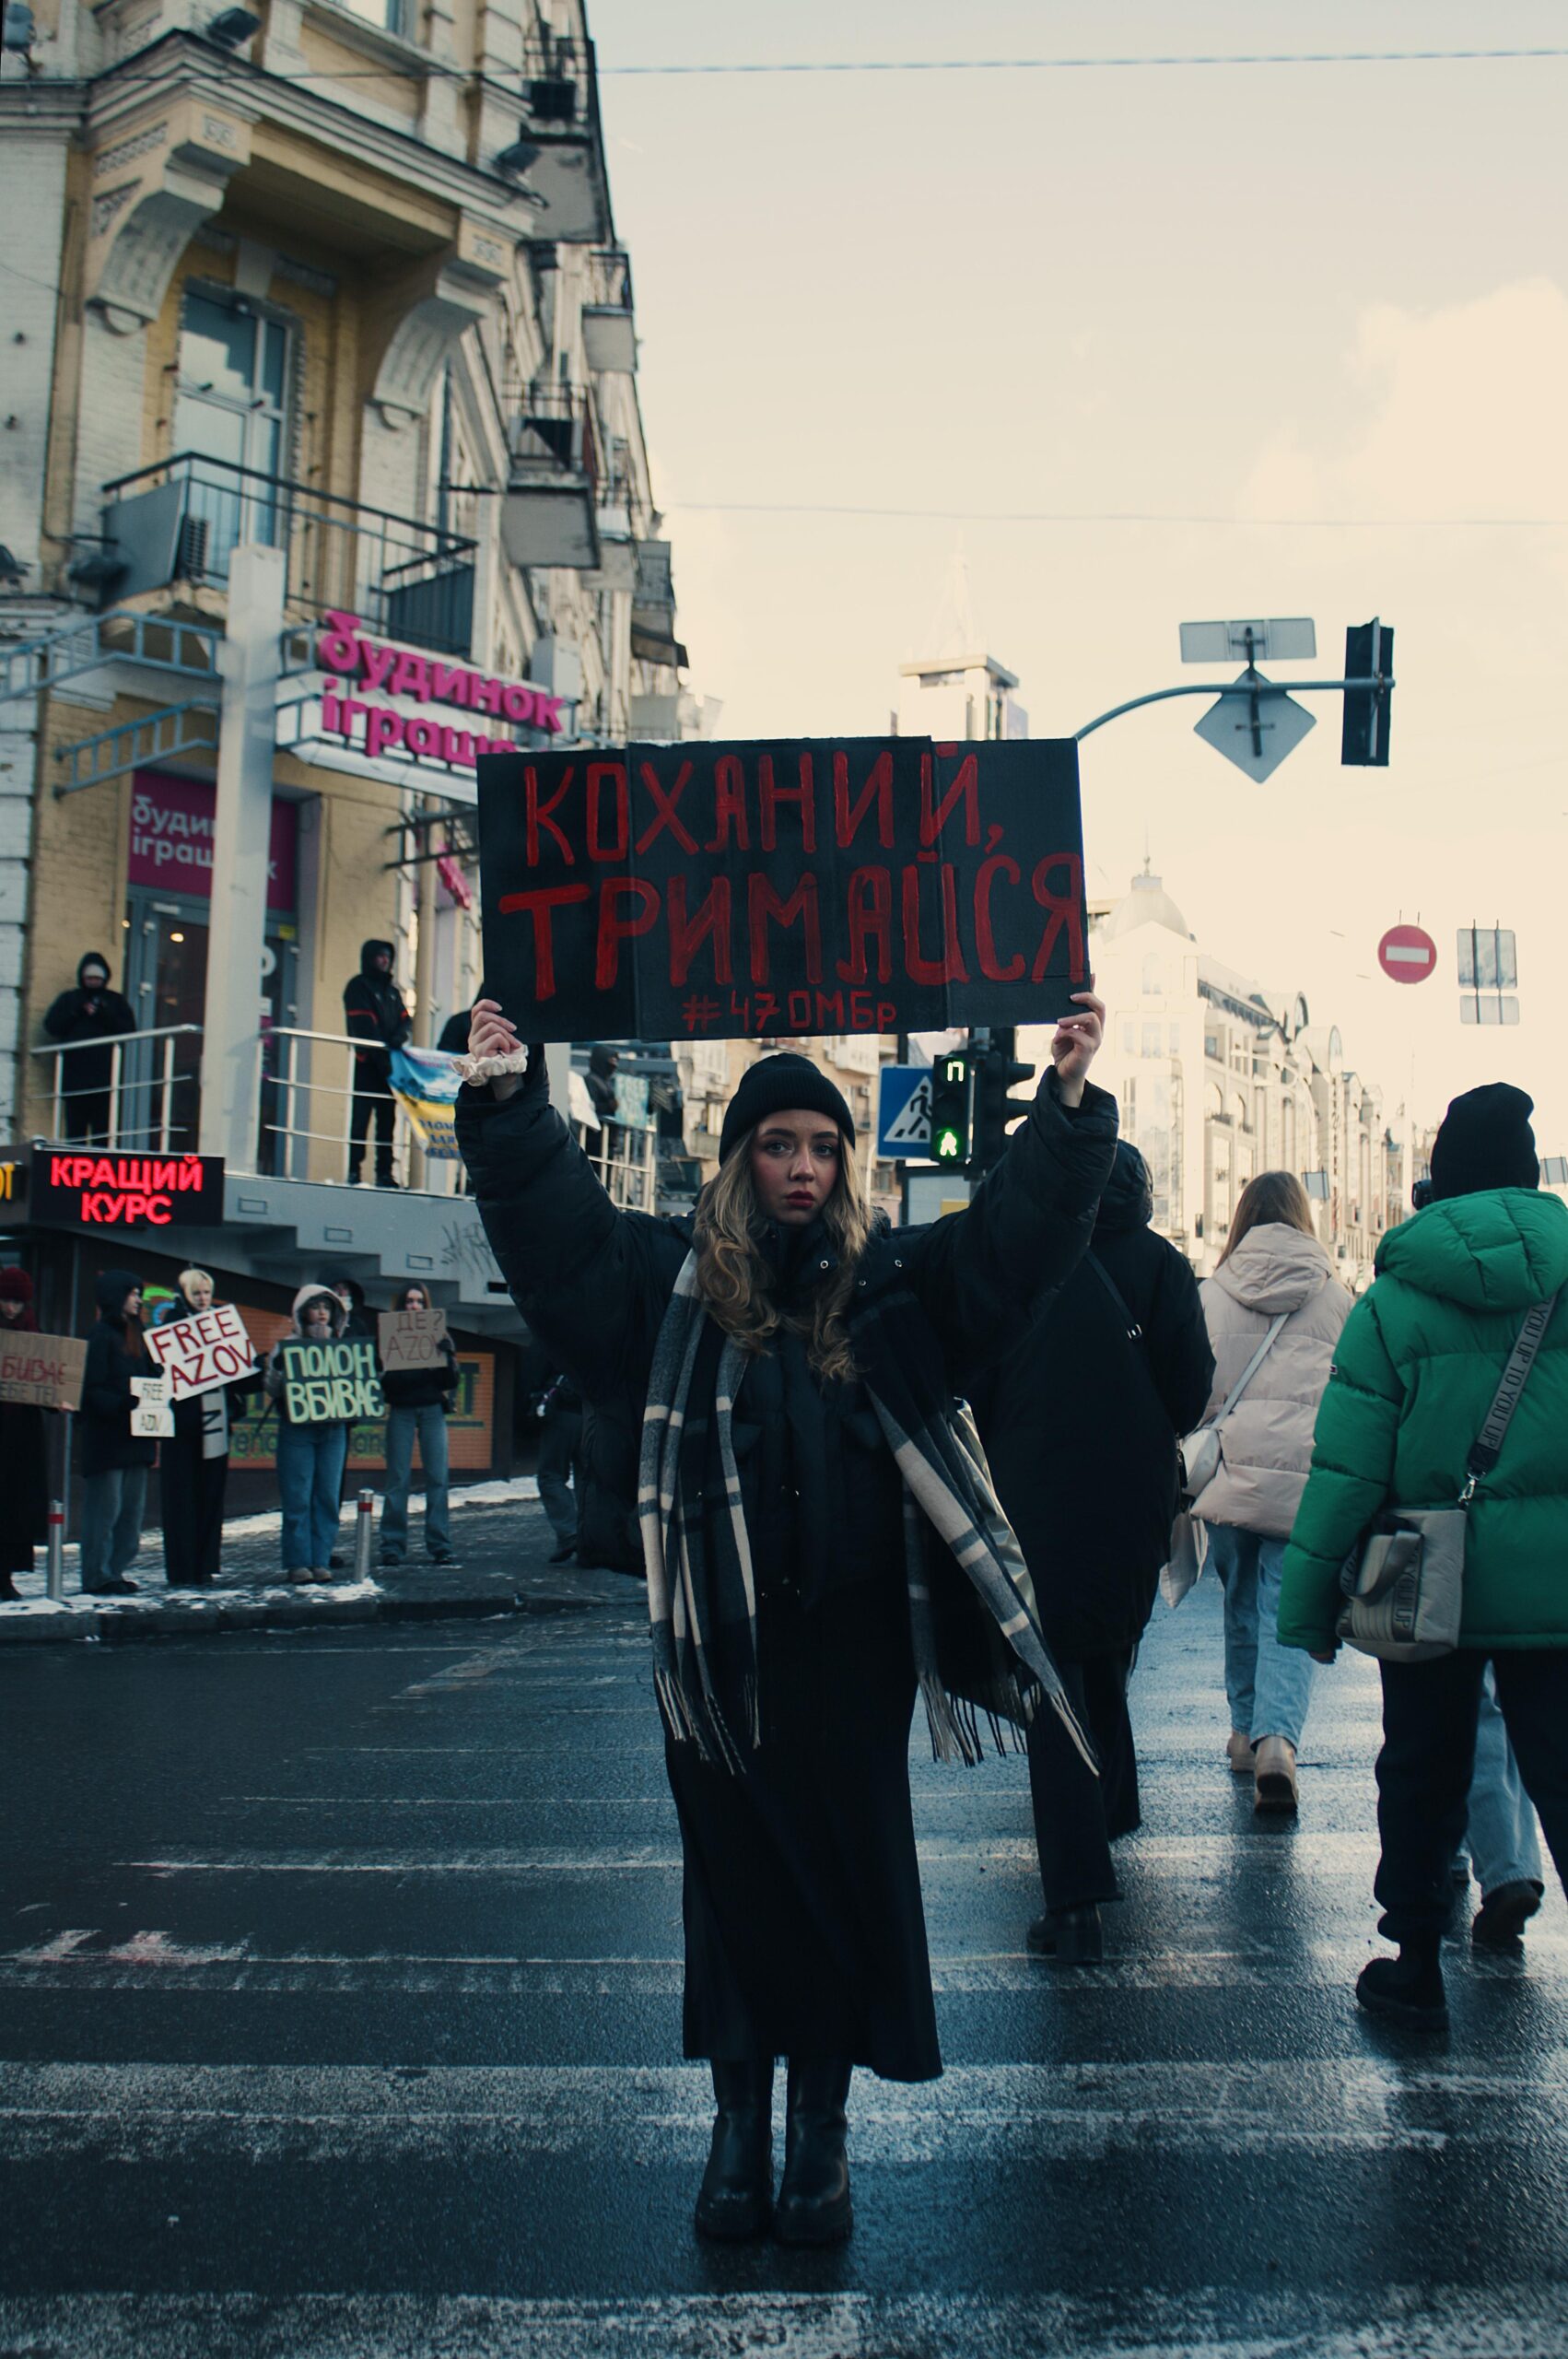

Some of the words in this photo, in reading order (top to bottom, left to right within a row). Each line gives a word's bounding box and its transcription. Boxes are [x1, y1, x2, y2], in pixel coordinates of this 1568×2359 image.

[320, 609, 564, 733] будинок
[322, 677, 553, 768] іграш
[524, 743, 1004, 867] КОХАНИЙ,
[498, 851, 1085, 1002] ТРИМАЙСЯ
[51, 1154, 204, 1195] КРАЩИЙ
[81, 1191, 173, 1225] КУРС
[150, 1310, 240, 1363] FREE
[1524, 1307, 1550, 1339] YOU
[170, 1339, 252, 1394] AZOV
[283, 1343, 377, 1380] ПОЛОН
[1515, 1341, 1536, 1364] UP
[1504, 1366, 1525, 1387] TO
[285, 1379, 386, 1424] ВБИВАЄ
[1491, 1389, 1518, 1422] YOU
[1482, 1424, 1503, 1449] UP
